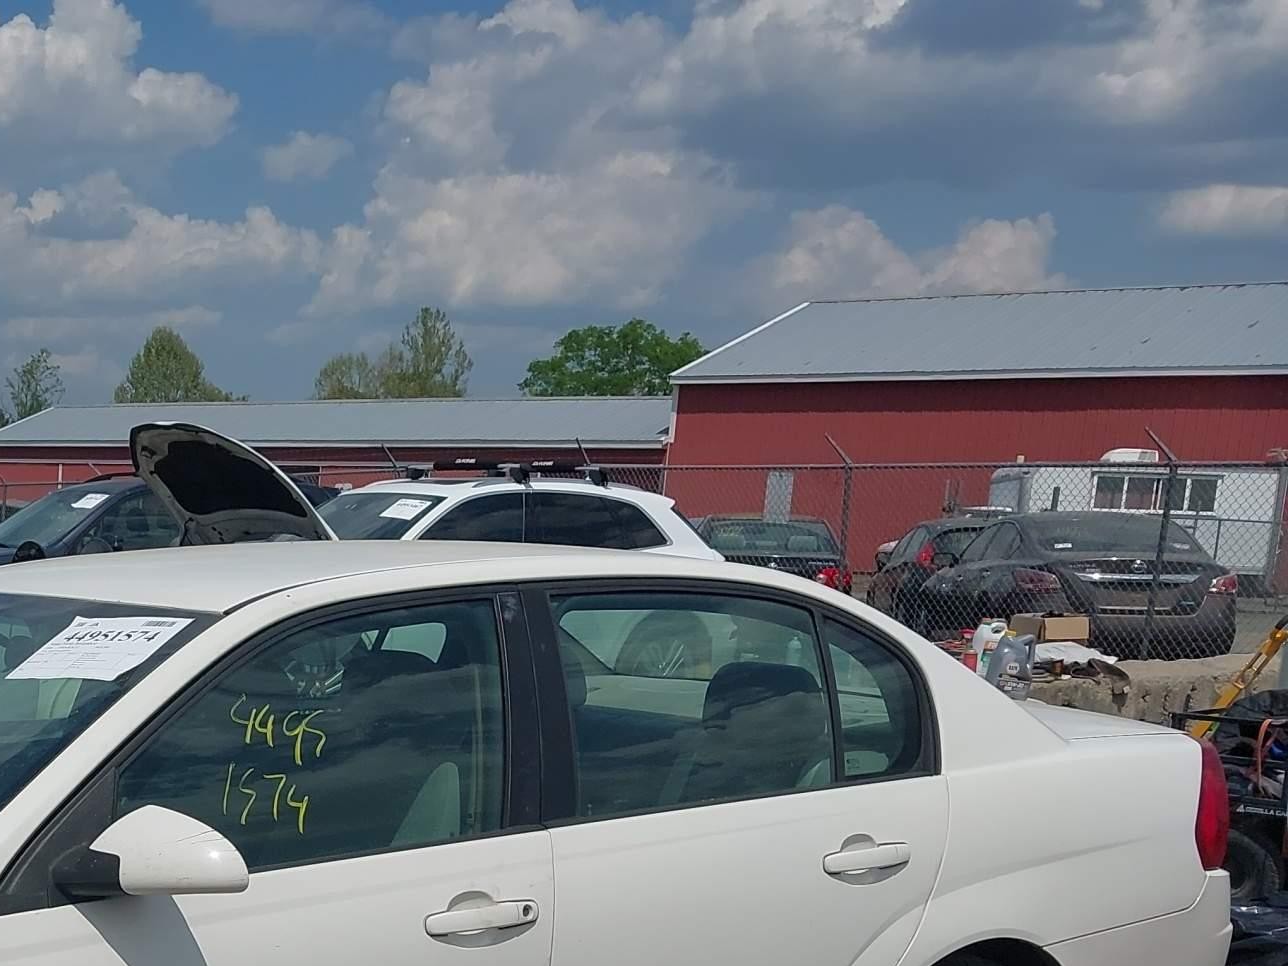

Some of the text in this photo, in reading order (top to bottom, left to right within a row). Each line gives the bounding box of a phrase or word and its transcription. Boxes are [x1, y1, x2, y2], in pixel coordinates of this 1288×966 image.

[64, 630, 161, 643] 44951574
[230, 694, 327, 766] 4495
[223, 761, 309, 834] 1574
